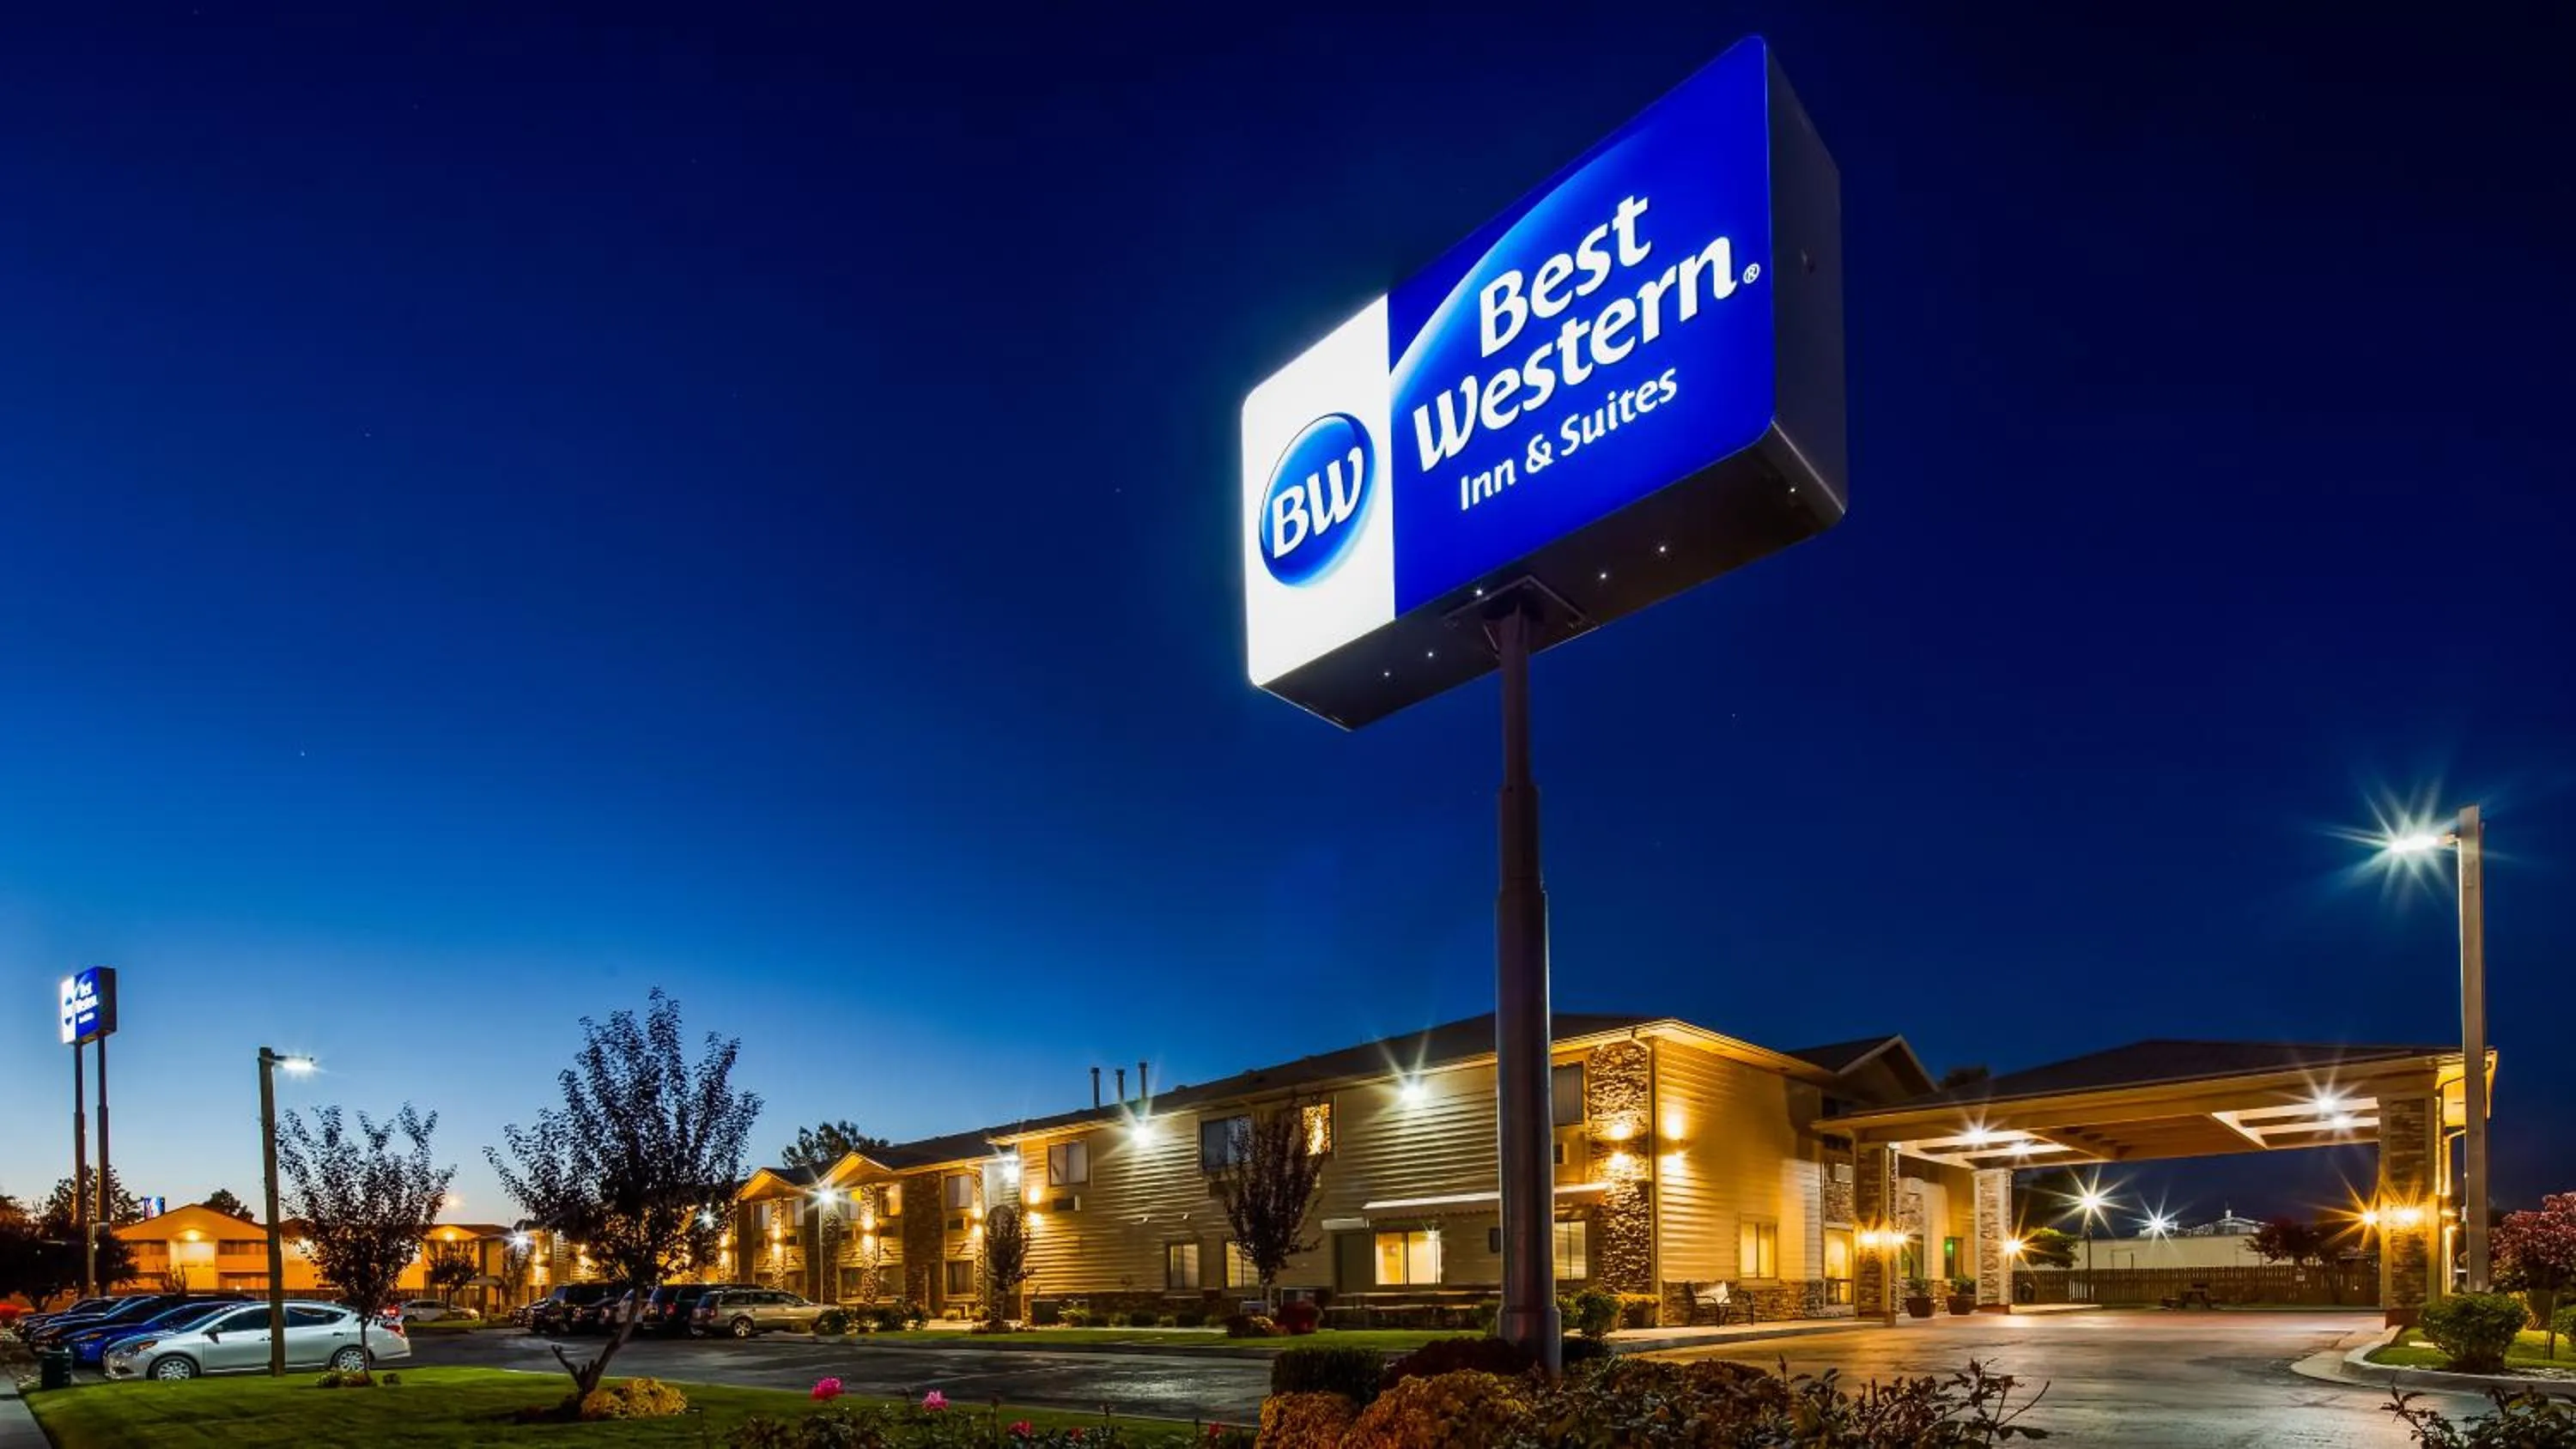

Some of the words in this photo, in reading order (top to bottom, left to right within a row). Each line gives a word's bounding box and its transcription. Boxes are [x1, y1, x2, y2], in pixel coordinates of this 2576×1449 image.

[1479, 195, 1651, 358] Best
[1273, 446, 1364, 558] BW
[1461, 459, 1517, 511] Inn
[1526, 434, 1553, 474] &
[1560, 367, 1677, 457] Suites
